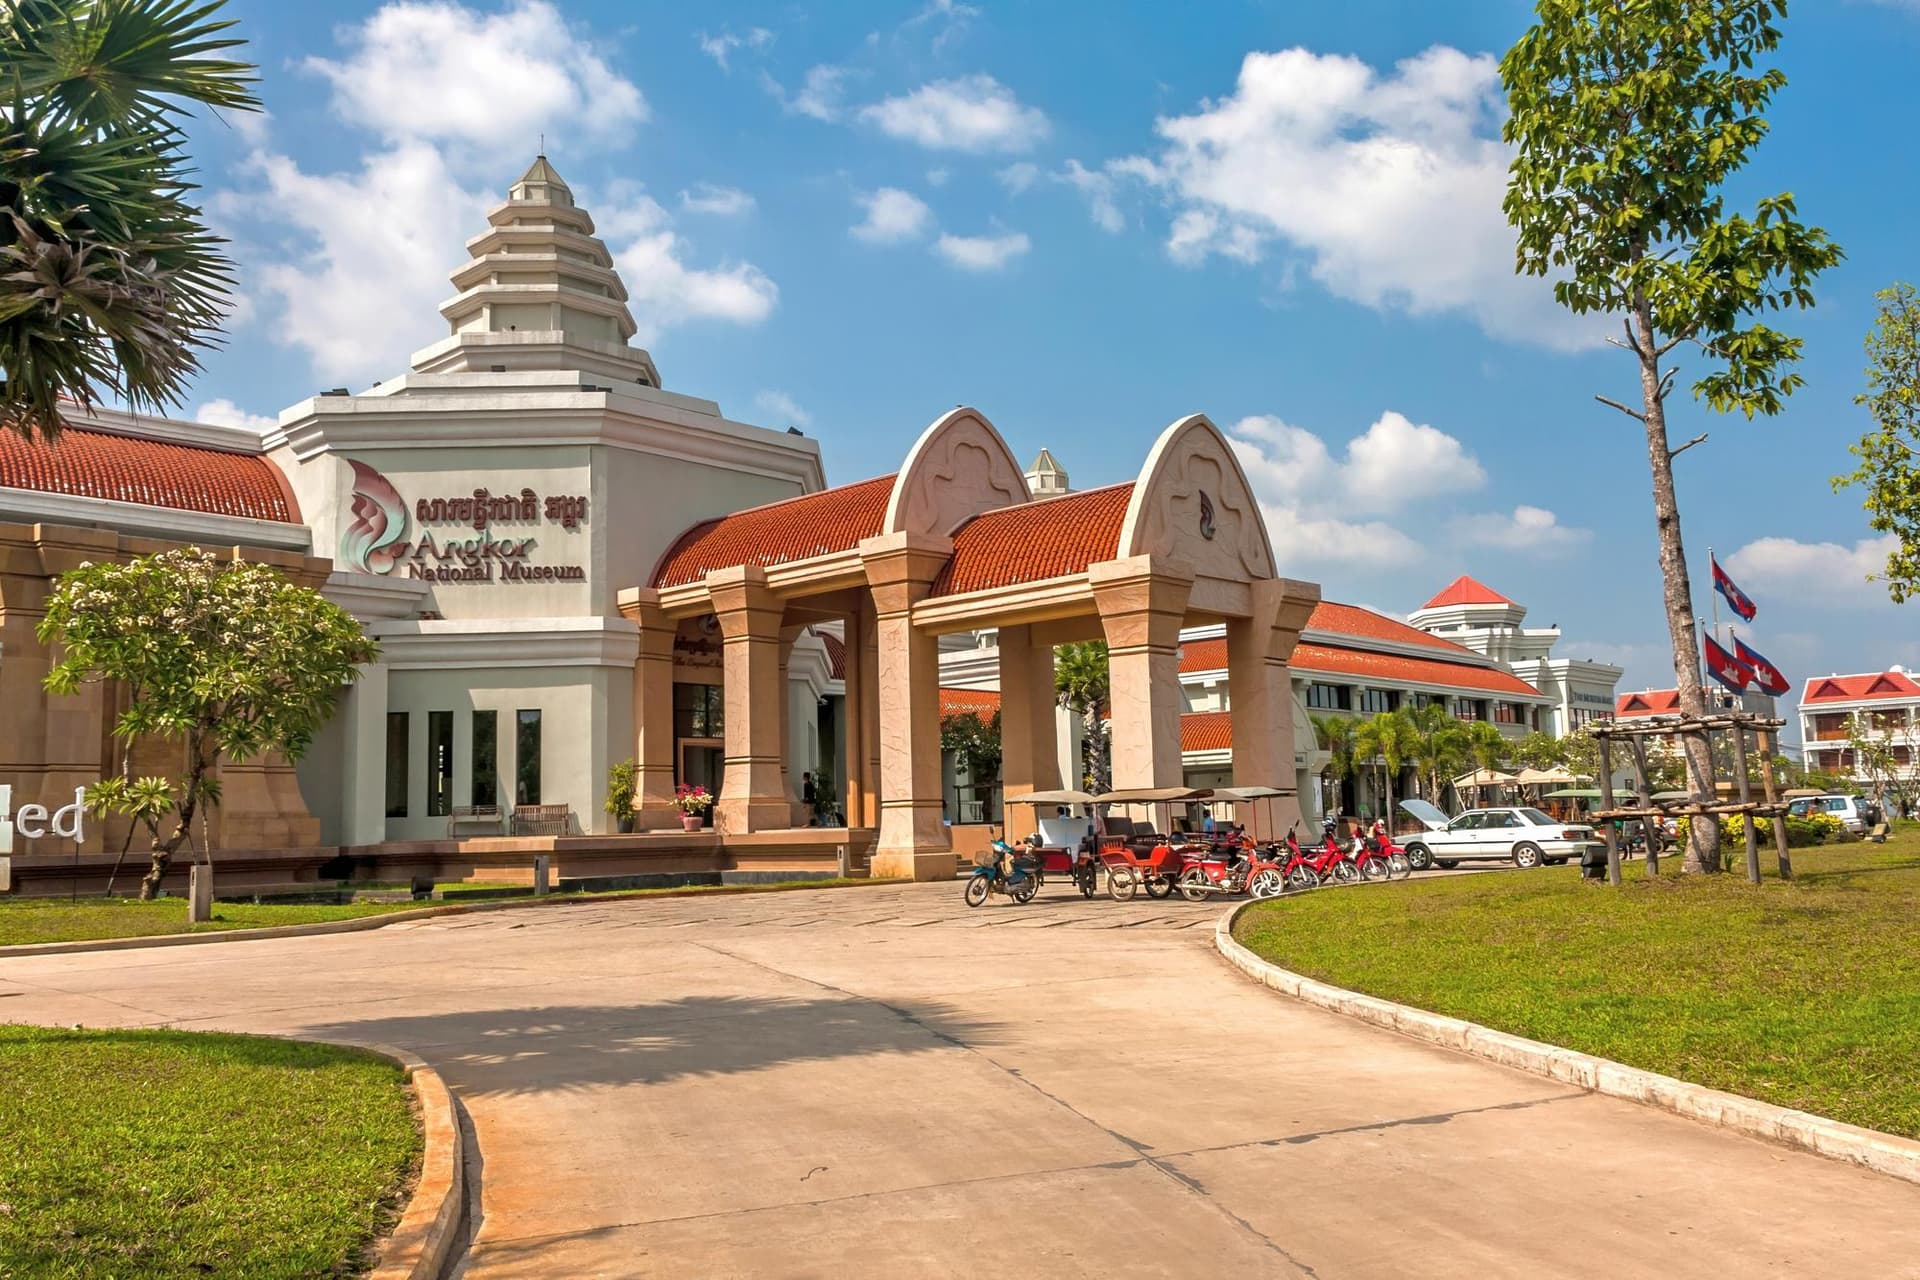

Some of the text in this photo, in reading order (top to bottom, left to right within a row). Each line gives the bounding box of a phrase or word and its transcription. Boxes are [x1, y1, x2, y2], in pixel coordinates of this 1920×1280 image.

[410, 529, 535, 567] Angkor
[408, 560, 585, 582] National Museum
